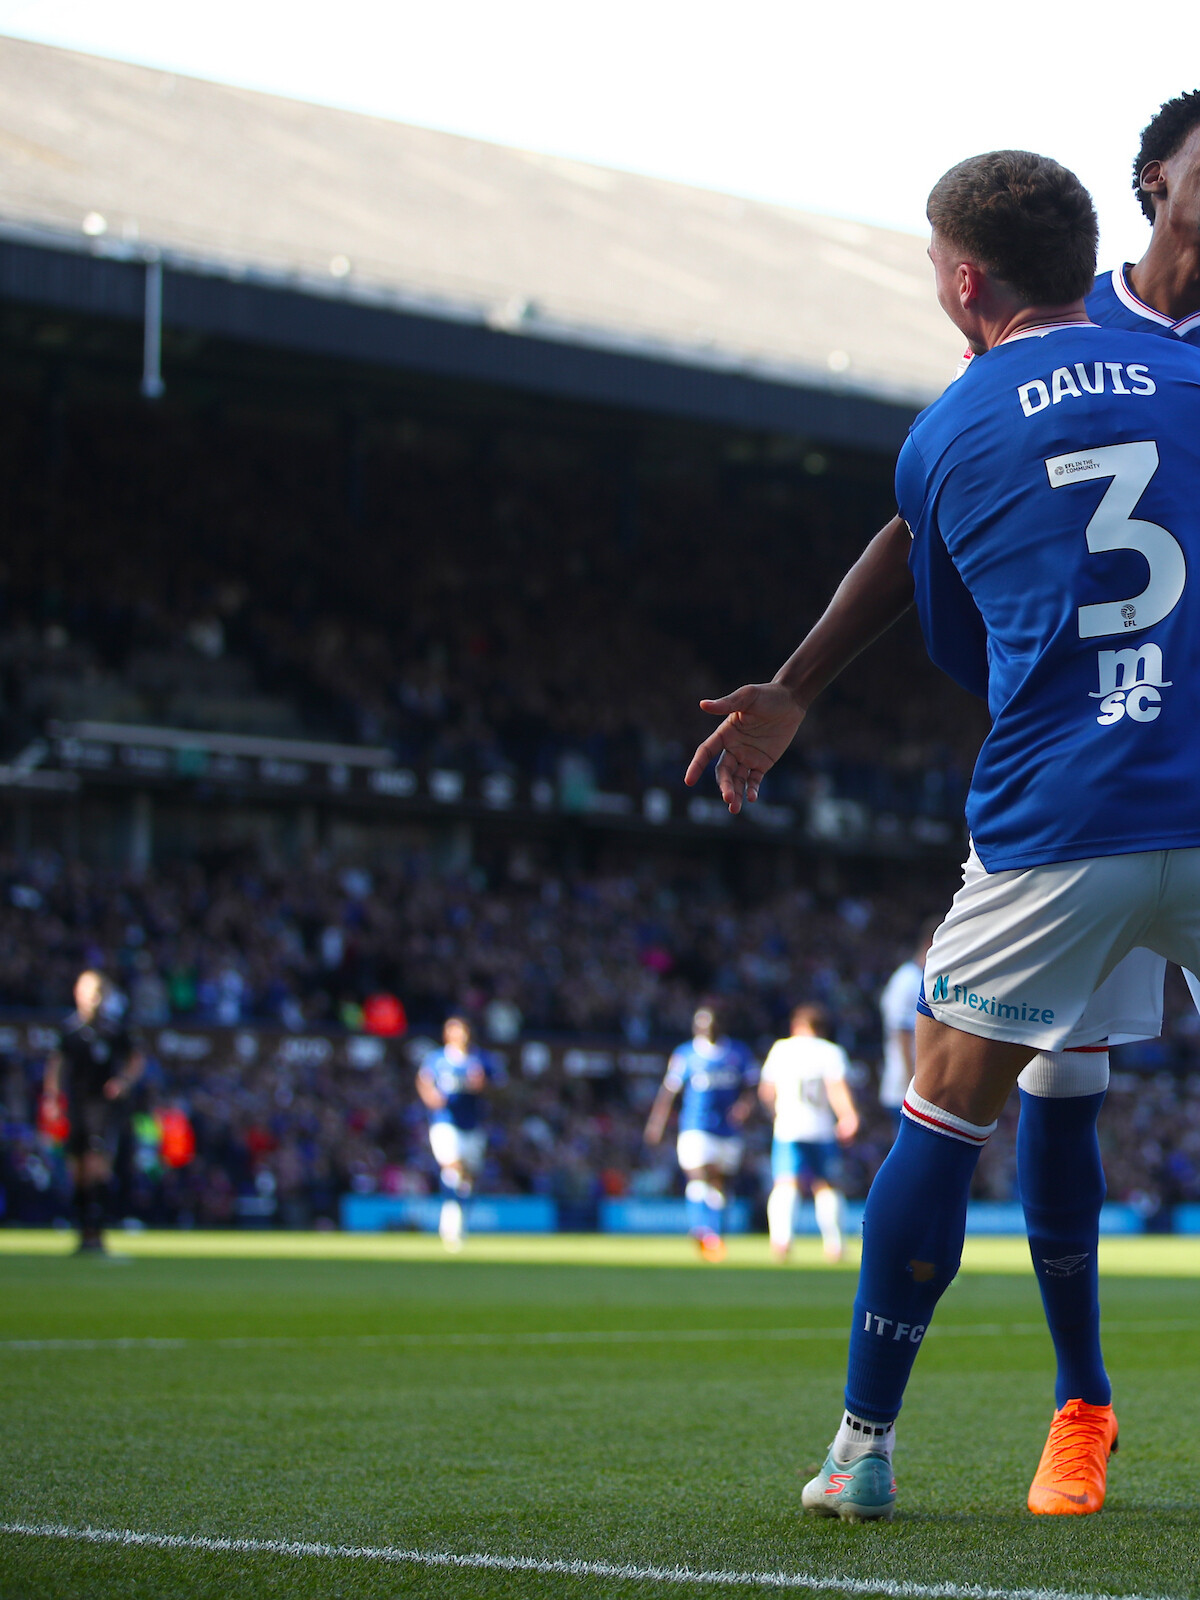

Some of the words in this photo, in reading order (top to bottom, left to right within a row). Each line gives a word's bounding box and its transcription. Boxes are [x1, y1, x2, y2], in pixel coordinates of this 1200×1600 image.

[1017, 361, 1157, 418] DAVIS
[1066, 463, 1100, 474] COMMUNITY
[1044, 440, 1187, 639] 3
[1123, 619, 1138, 628] EFL
[953, 984, 1055, 1025] fleximize
